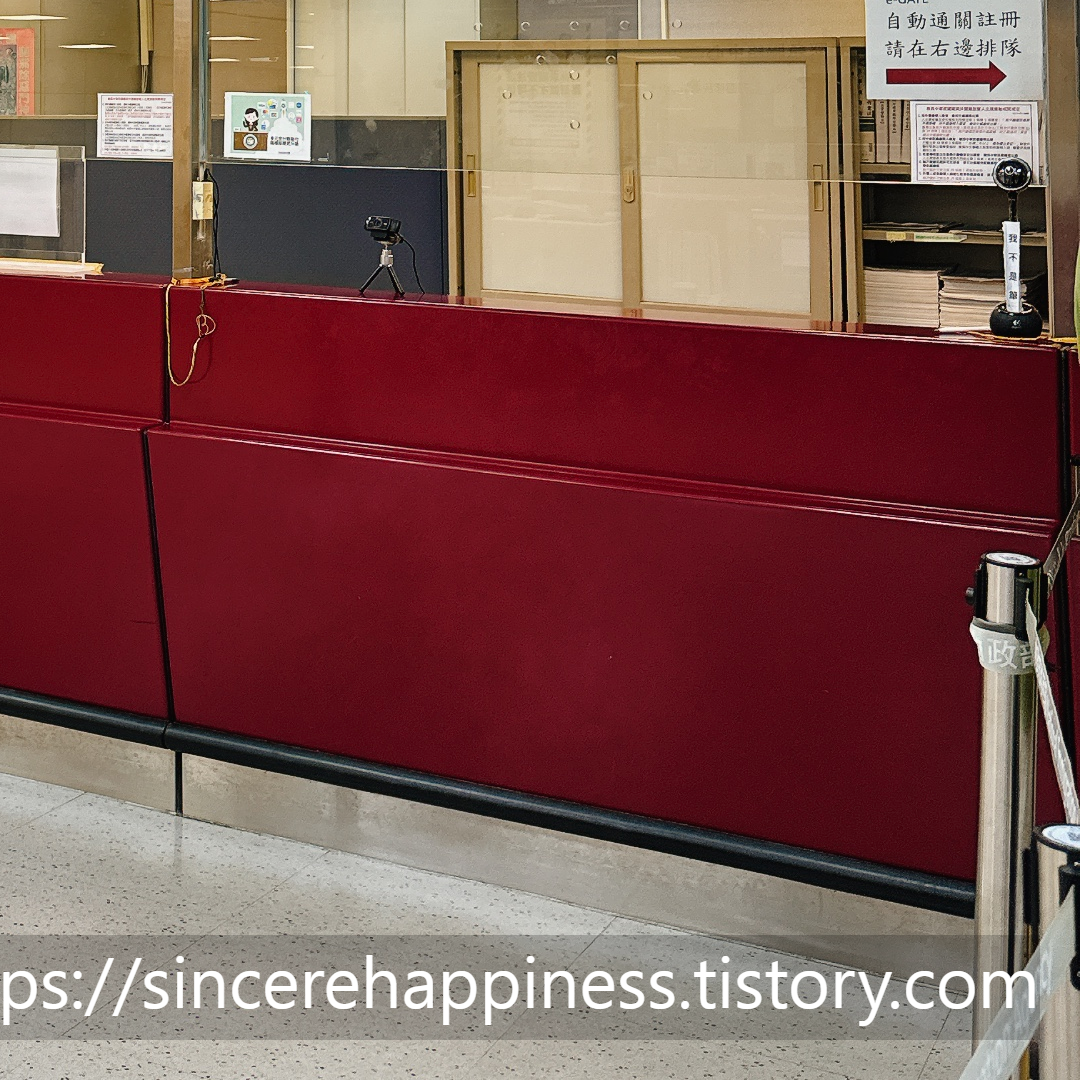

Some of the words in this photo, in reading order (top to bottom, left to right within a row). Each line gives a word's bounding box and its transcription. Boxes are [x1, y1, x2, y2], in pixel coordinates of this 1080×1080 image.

[887, 10, 1021, 31] 自動通關註冊
[885, 37, 1022, 58] 請在右邊排隊
